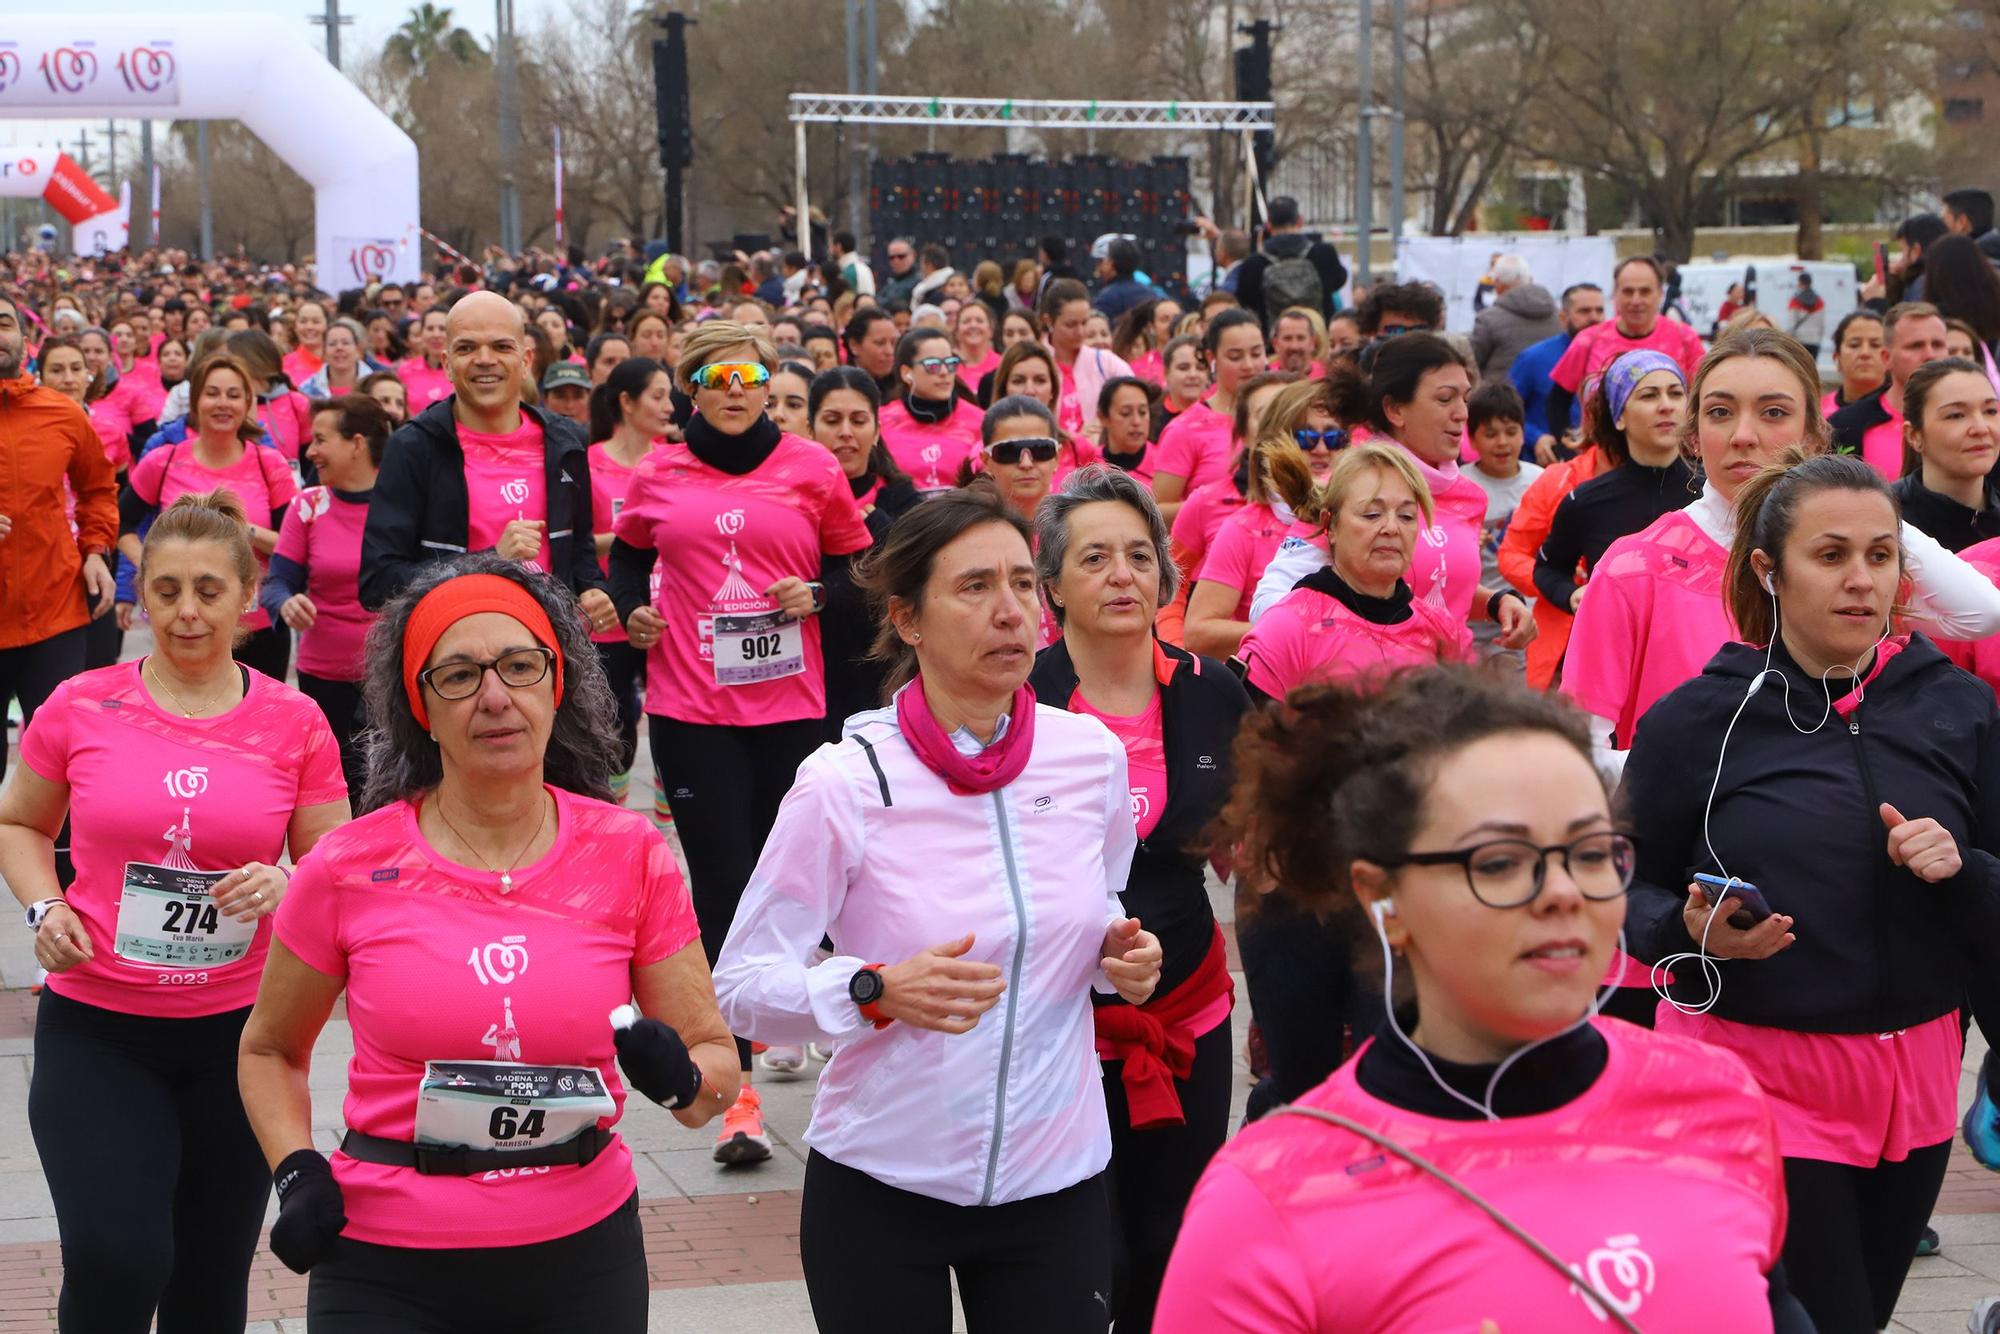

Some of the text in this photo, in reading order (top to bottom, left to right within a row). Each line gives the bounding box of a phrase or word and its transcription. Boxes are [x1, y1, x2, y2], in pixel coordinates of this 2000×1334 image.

[724, 601, 770, 612] EDICIÓN
[741, 633, 781, 661] 902
[176, 877, 205, 885] CADENA
[161, 900, 219, 935] 274
[157, 972, 209, 985] 2023
[495, 1075, 549, 1083] CADENA 100
[510, 1082, 534, 1090] POR
[503, 1089, 540, 1097] ELLAS
[488, 1105, 546, 1140] 64
[494, 1139, 532, 1148] MARISOL
